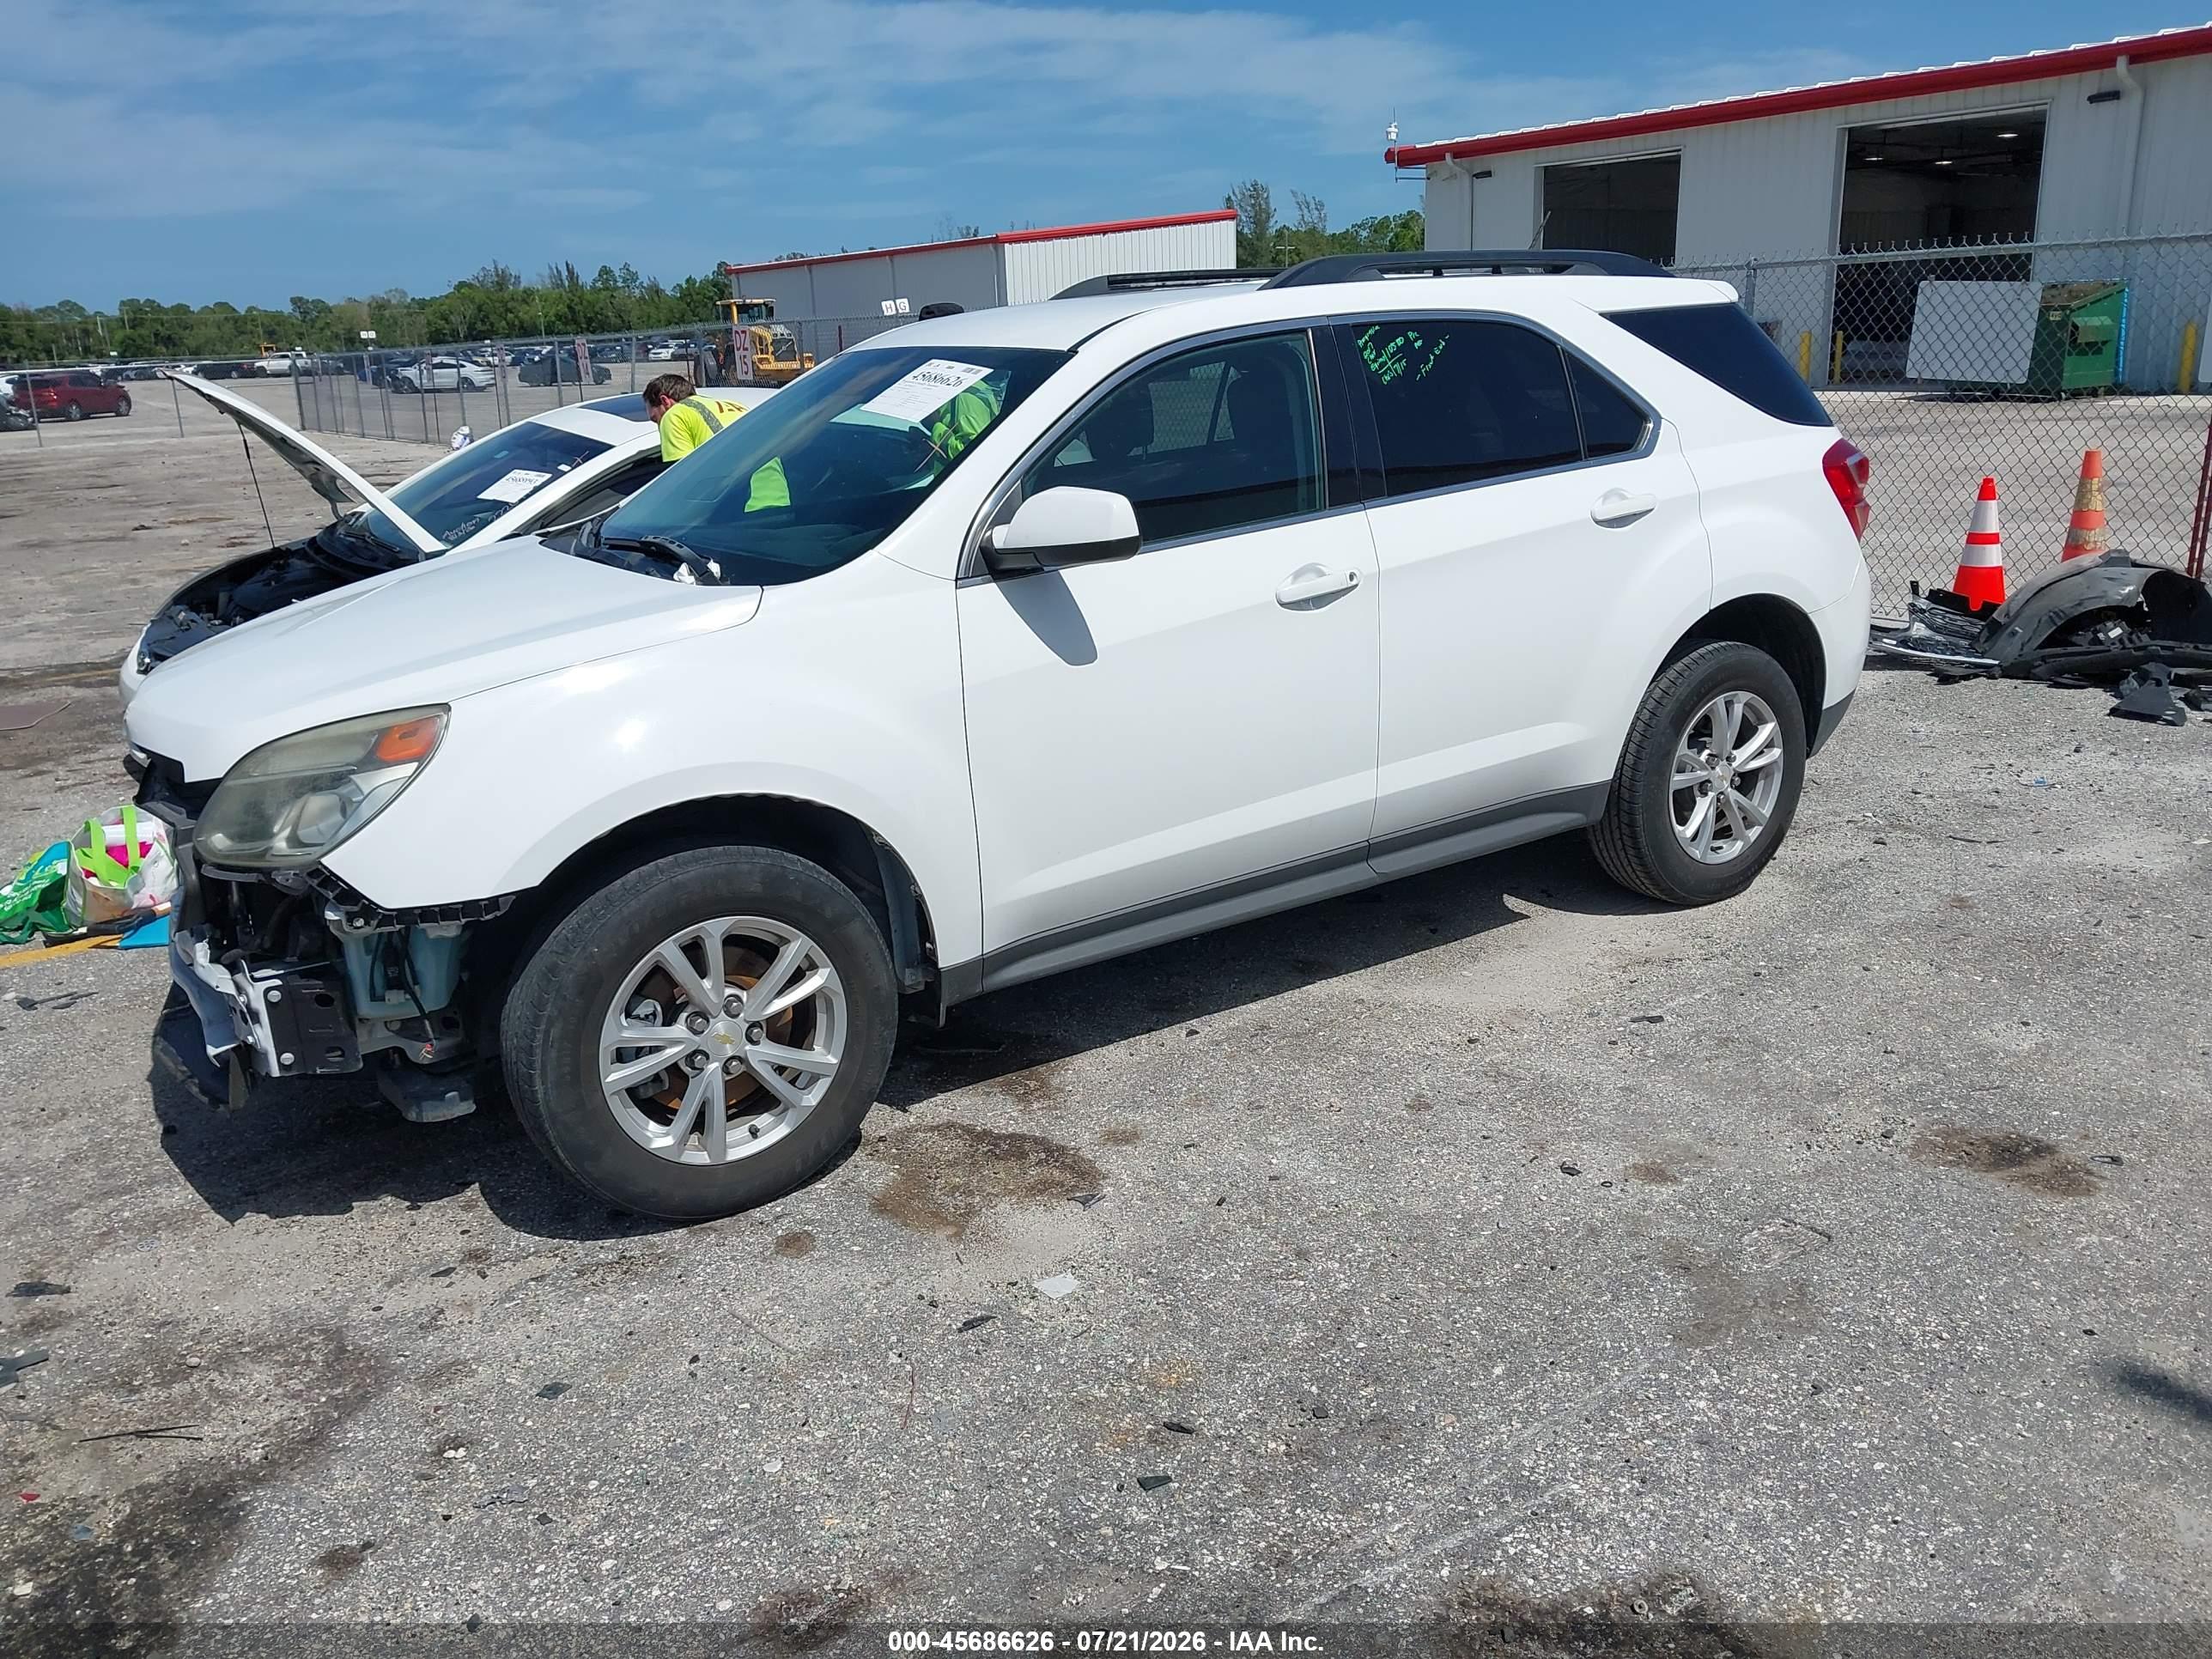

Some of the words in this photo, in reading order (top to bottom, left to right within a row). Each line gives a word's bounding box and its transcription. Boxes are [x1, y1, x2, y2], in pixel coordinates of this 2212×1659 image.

[884, 303, 893, 313] H
[898, 301, 907, 311] G
[734, 330, 749, 351] DZ
[739, 355, 749, 375] 15
